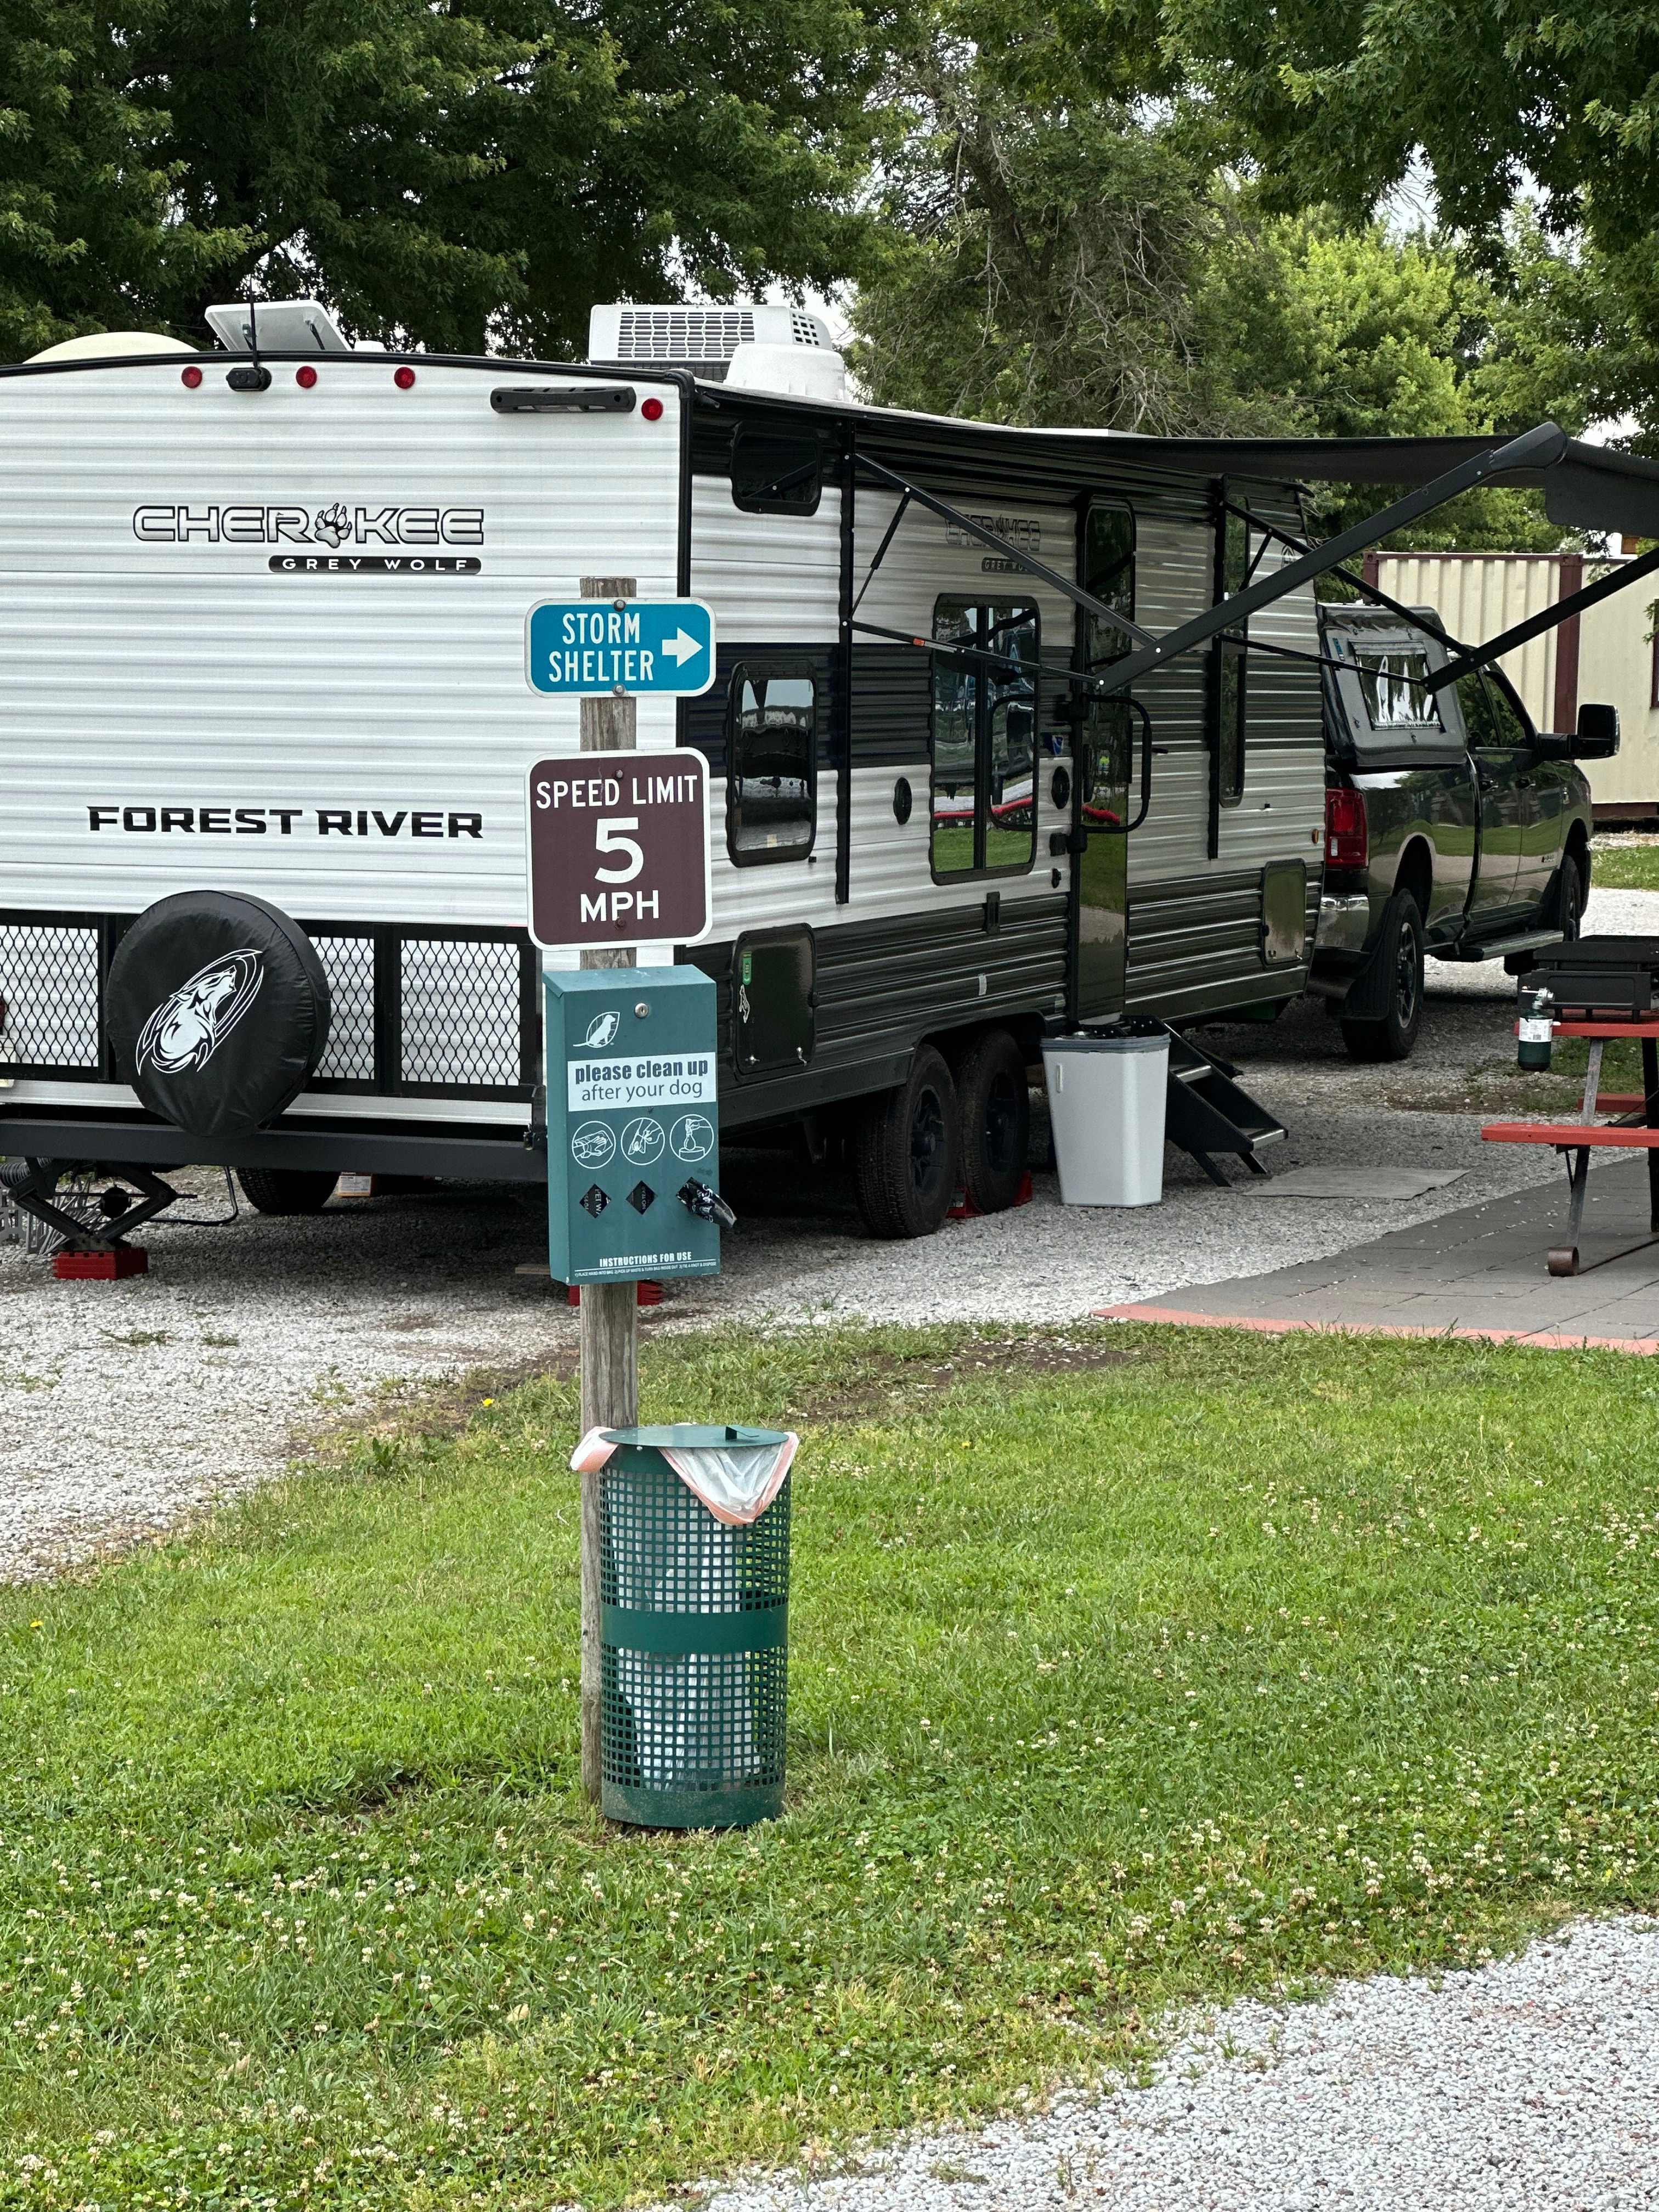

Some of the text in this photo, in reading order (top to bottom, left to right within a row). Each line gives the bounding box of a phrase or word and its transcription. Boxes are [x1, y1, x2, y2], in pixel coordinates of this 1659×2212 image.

[283, 558, 467, 572] GREY WOLF
[984, 560, 1007, 571] GREY
[562, 612, 640, 645] STORM
[548, 650, 654, 682] SHELTER
[535, 775, 698, 809] SPEED LIMIT
[86, 805, 484, 839] FOREST RIVER
[594, 816, 644, 884] 5
[580, 889, 659, 923] MPH
[575, 1059, 709, 1085] please clean up
[582, 1079, 703, 1102] after your dog
[599, 1251, 692, 1267] INSTRUCTIONS FOR USE
